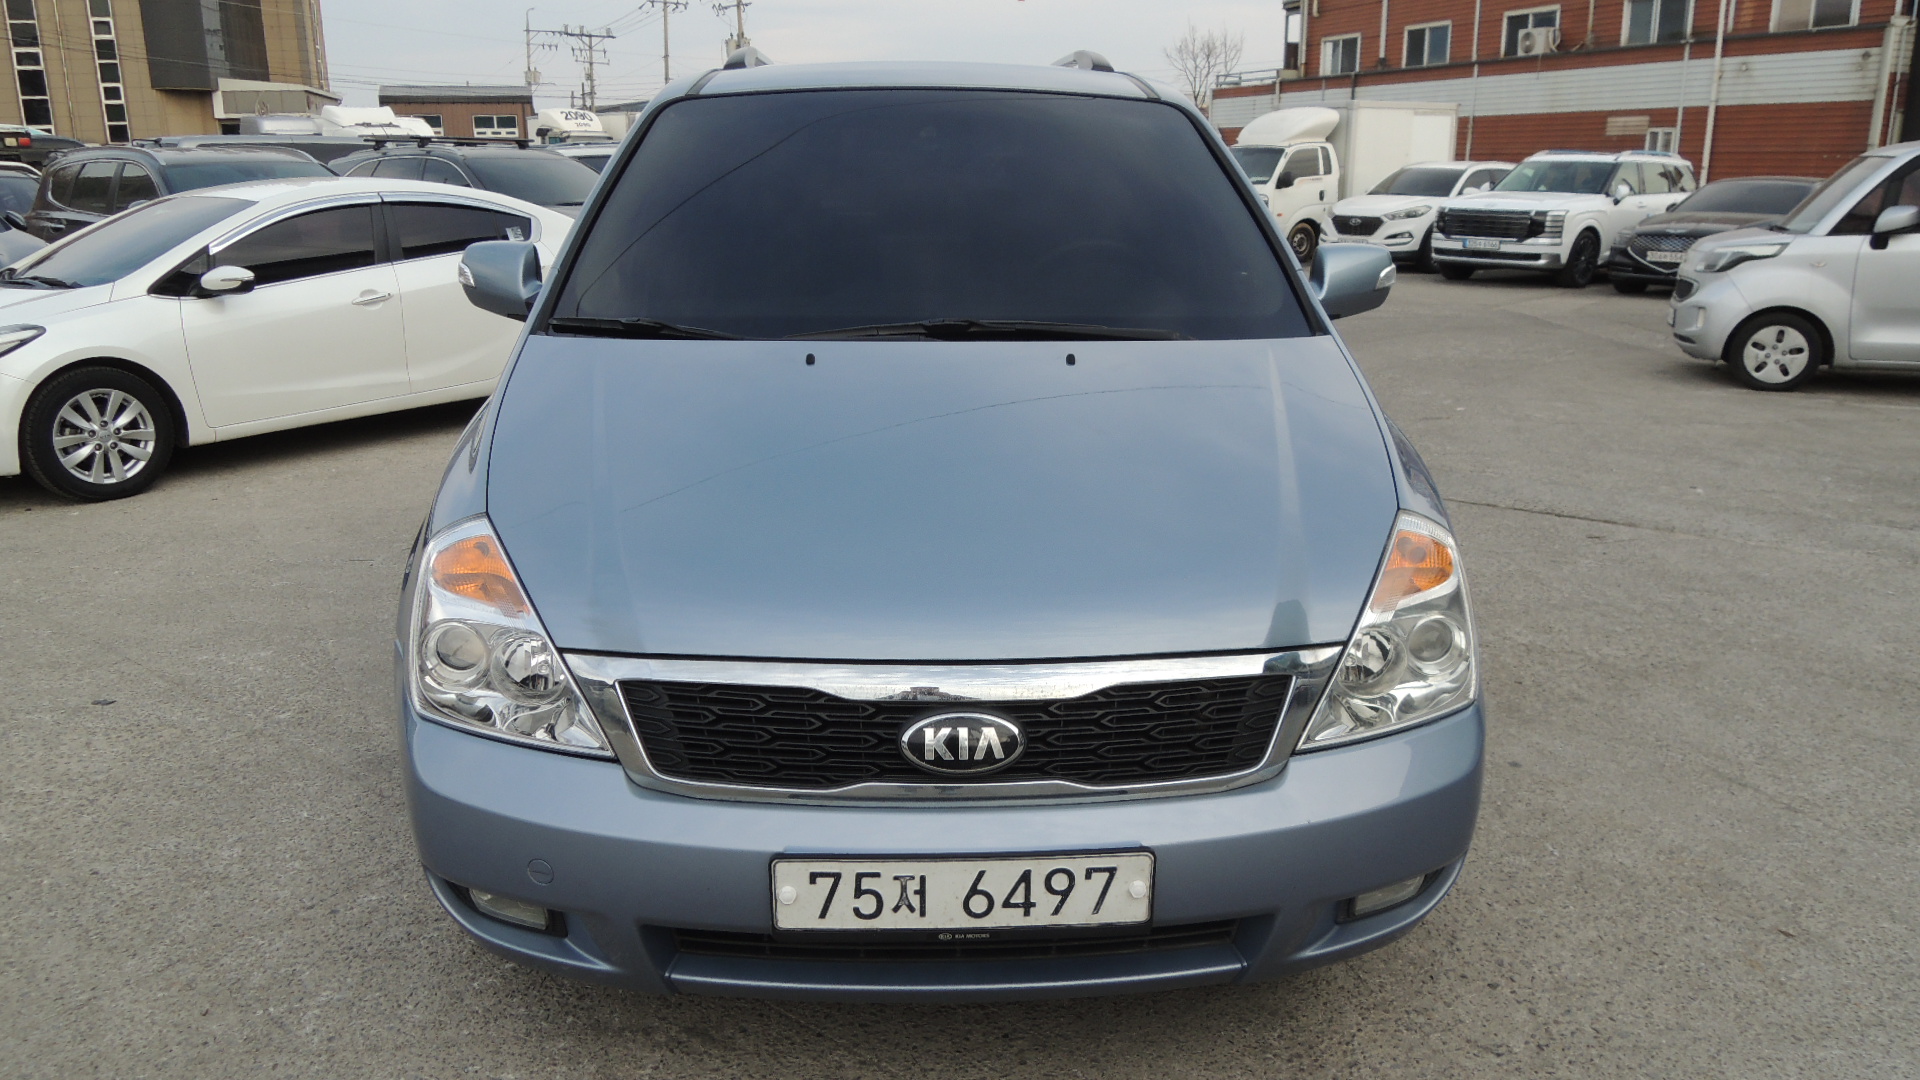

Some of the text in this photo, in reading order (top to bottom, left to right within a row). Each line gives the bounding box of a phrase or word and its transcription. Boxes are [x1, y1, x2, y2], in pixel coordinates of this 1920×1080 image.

[560, 110, 594, 122] 2090
[922, 726, 1005, 761] KIA
[808, 866, 1119, 920] 75저 6497
